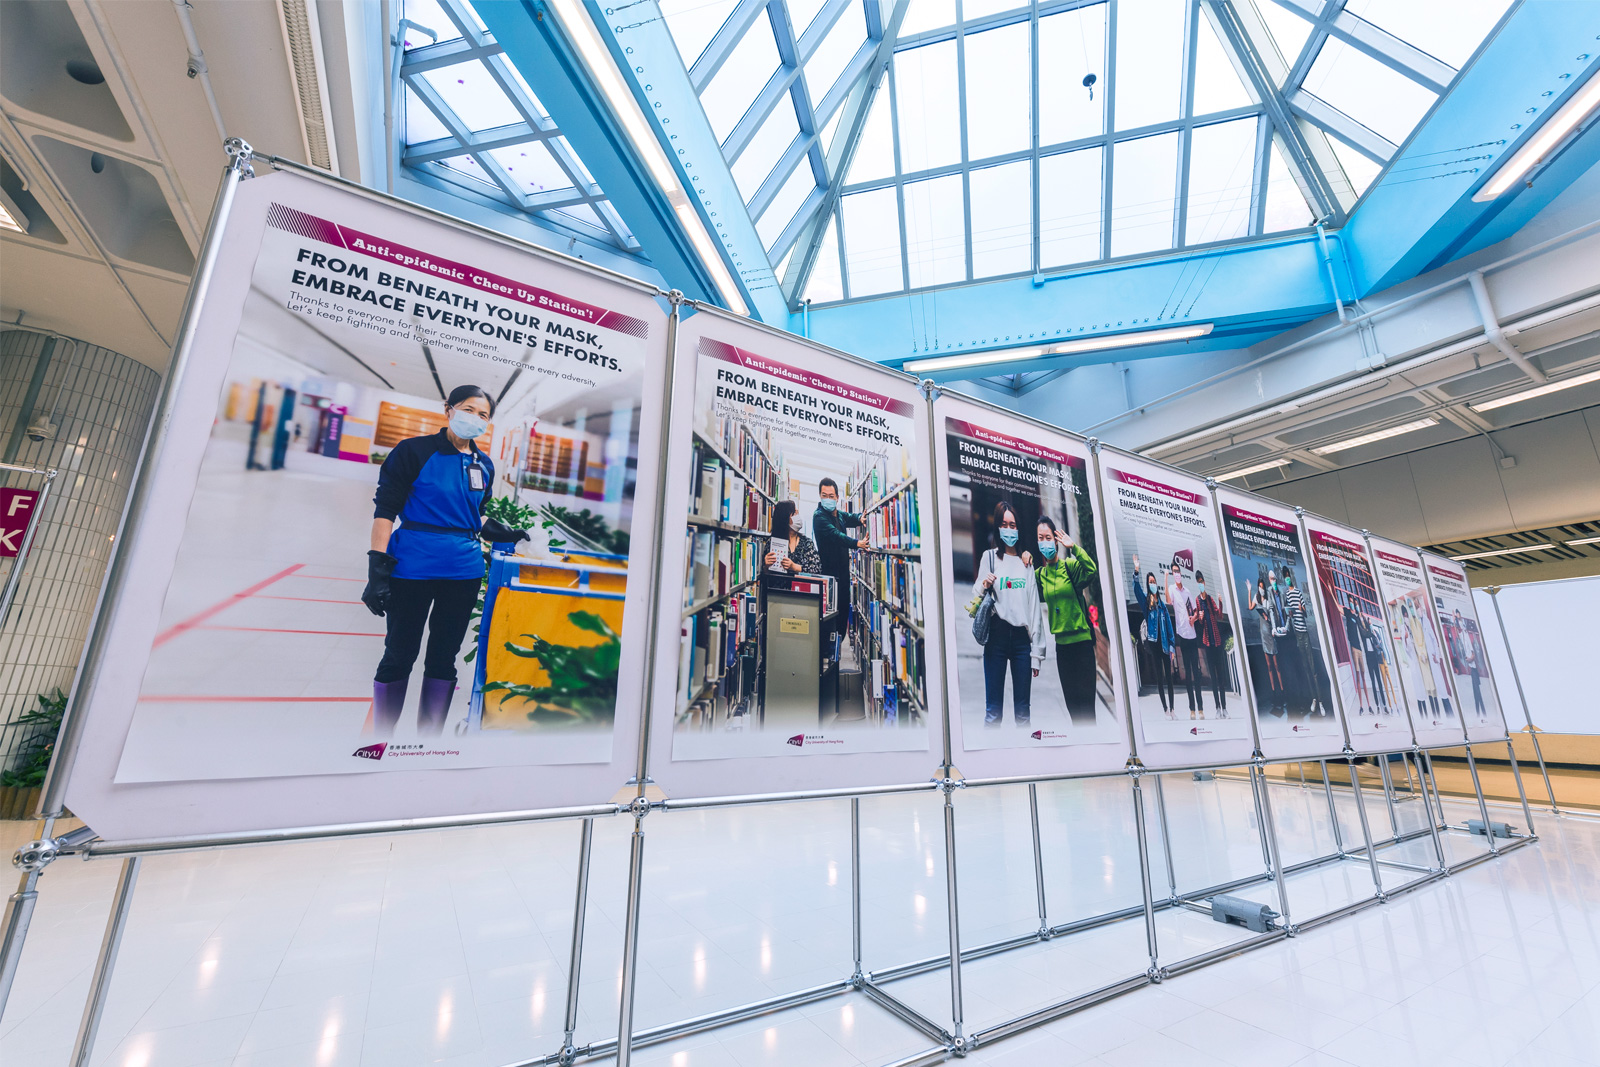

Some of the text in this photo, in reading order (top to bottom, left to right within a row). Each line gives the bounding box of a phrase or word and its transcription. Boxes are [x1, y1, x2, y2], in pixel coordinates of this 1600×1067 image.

[352, 237, 465, 281] Anti-epidemic
[517, 288, 536, 303] Up
[296, 248, 604, 350] FROM BENEATH YOUR MASK,
[289, 291, 500, 353] Thanks to everyone for their commitment.
[291, 269, 622, 373] EMBRACE EVERYONE'S EFFORTS.
[316, 308, 344, 323] keep
[346, 316, 387, 335] fighting
[389, 325, 410, 339] and
[412, 331, 453, 350] together
[456, 345, 470, 355] we
[472, 349, 489, 359] can
[491, 355, 535, 371] overcome
[537, 366, 559, 379] every
[561, 372, 597, 388] adversity.
[745, 357, 807, 382] Anti-epidemic
[837, 386, 848, 397] Up
[716, 386, 903, 447] EMBRACE EVERYONE'S EFFORTS.
[717, 369, 890, 430] FROM BENEATH YOUR MASK,
[716, 403, 833, 438] Thanks to everyone for their commitment.
[959, 441, 1072, 481] FROM BENEATH YOUR MASK,
[960, 455, 1000, 473] EMBRACE
[1050, 479, 1082, 495] EFFORTS.
[7, 494, 33, 516] F
[1117, 487, 1199, 517] FROM BENEATH YOUR MASK,
[1120, 499, 1149, 513] EMBRACE
[1183, 515, 1207, 529] EFFORTS.
[356, 749, 381, 759] CityU
